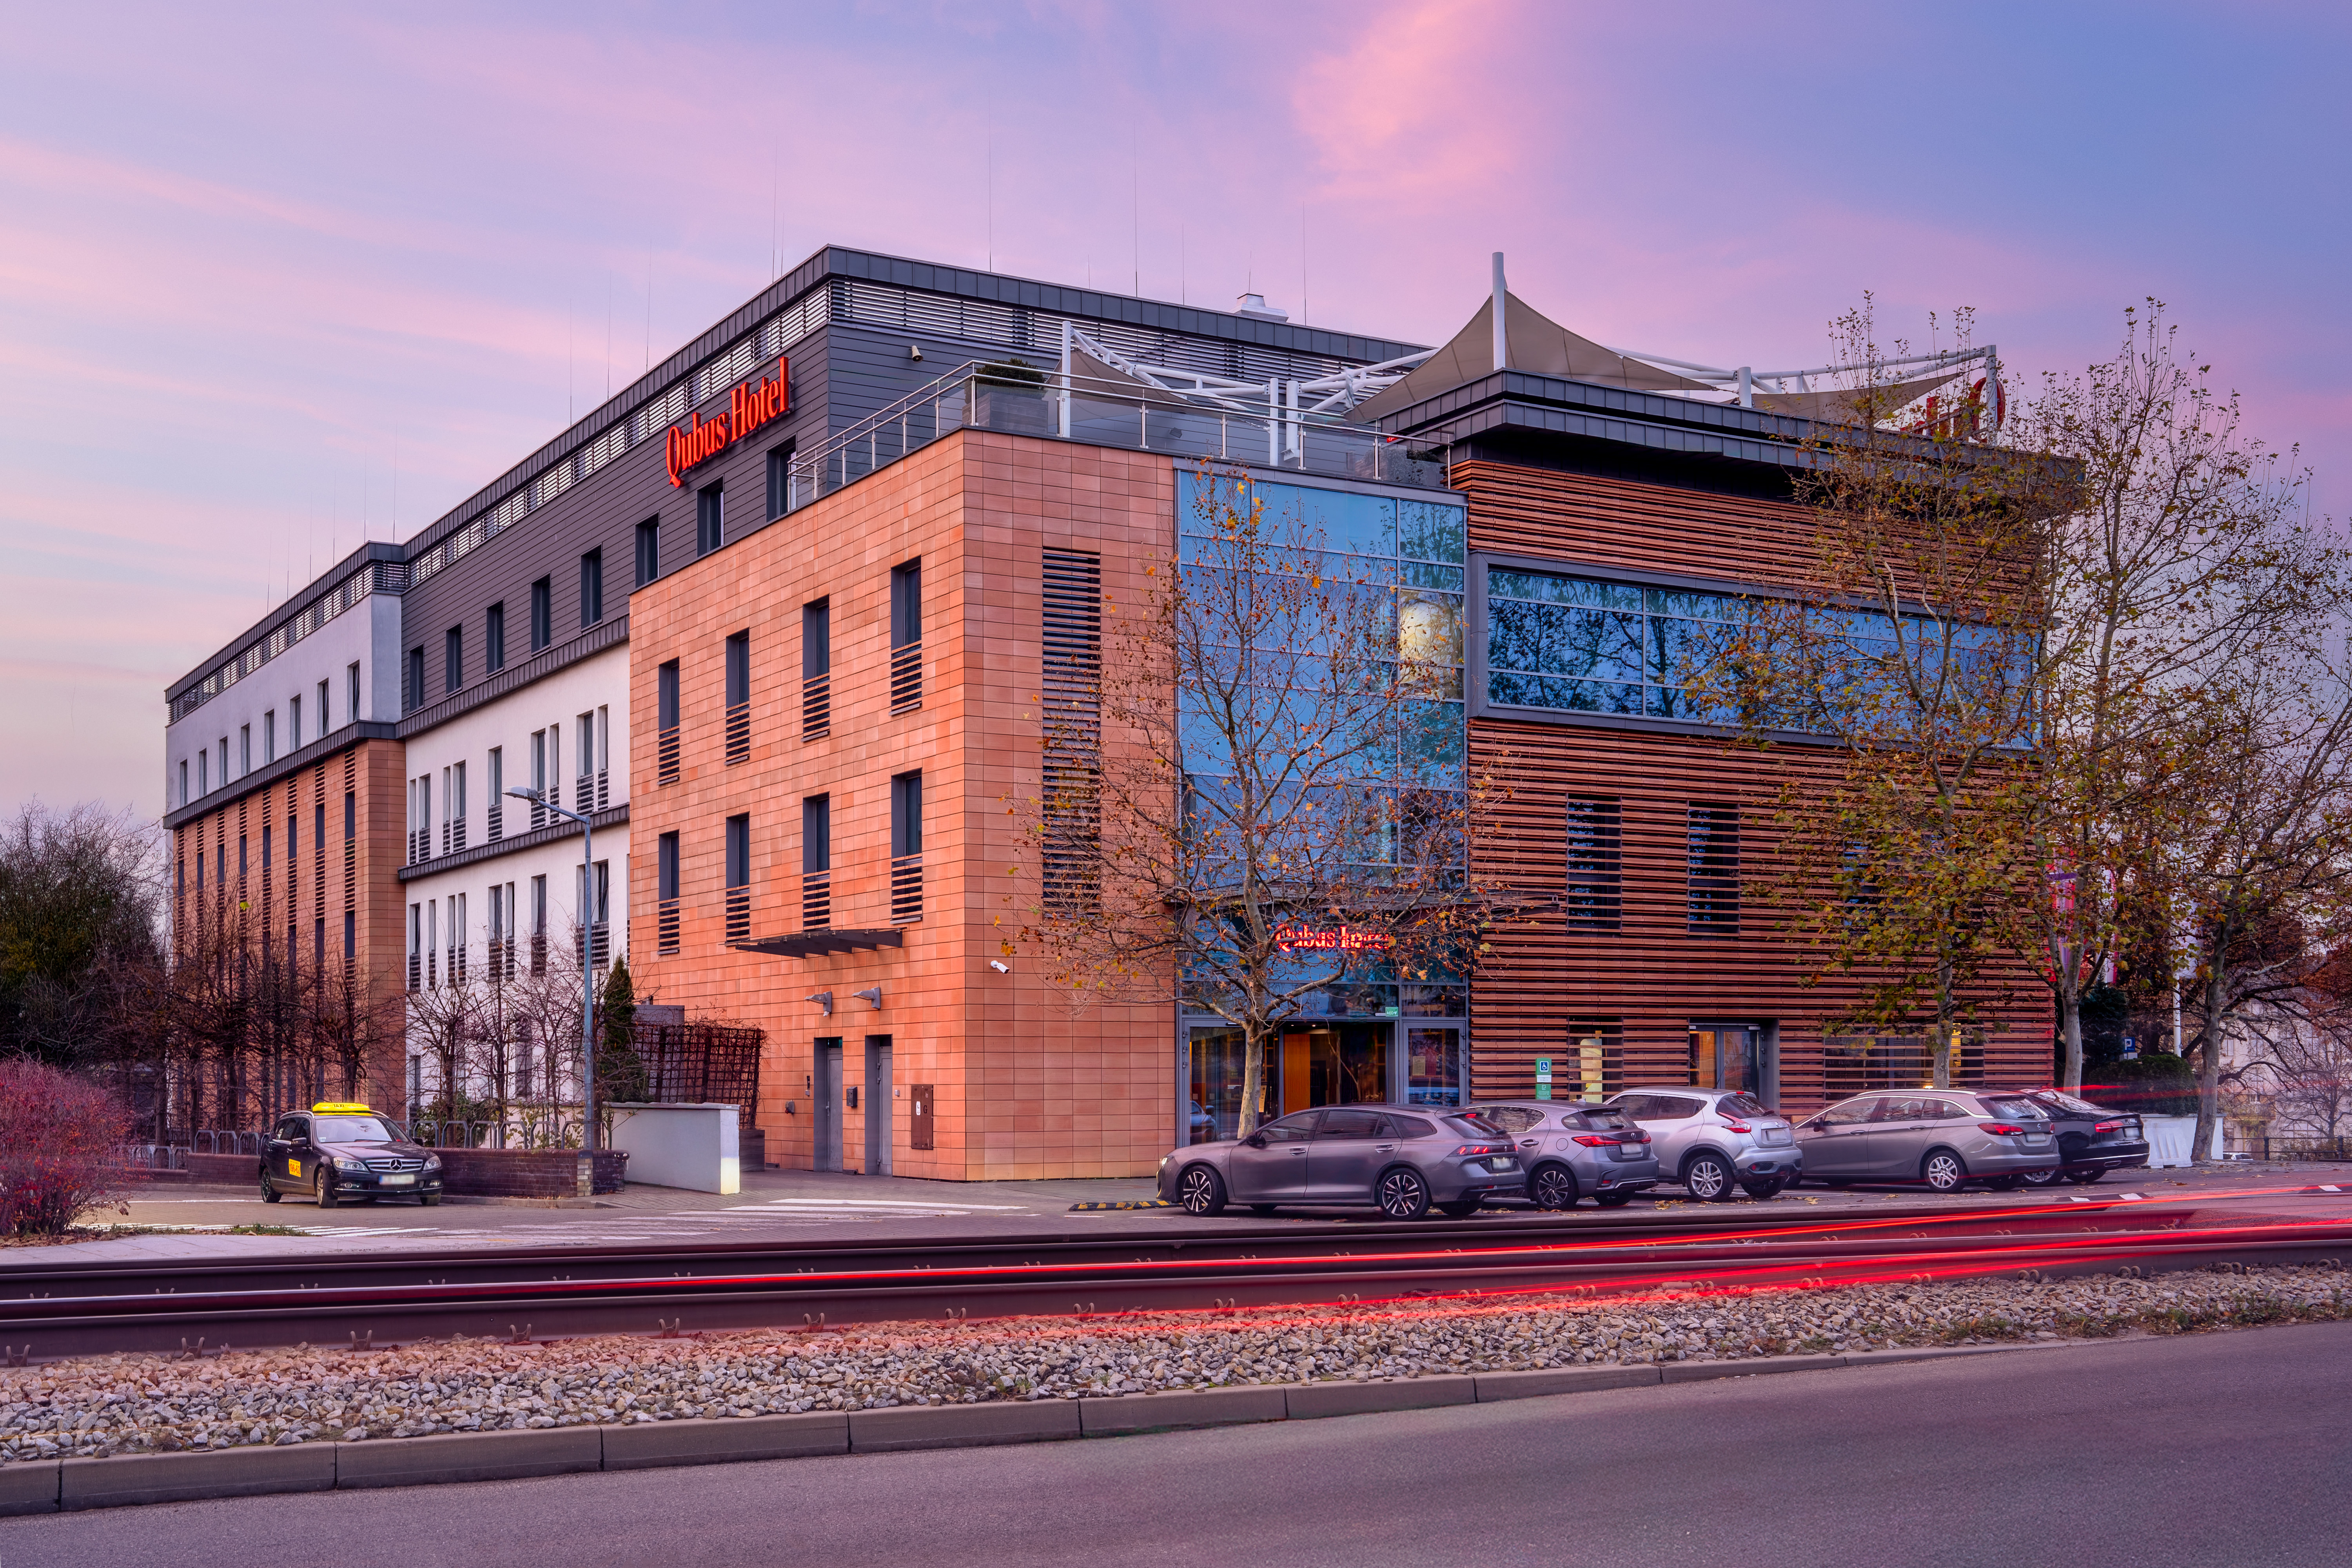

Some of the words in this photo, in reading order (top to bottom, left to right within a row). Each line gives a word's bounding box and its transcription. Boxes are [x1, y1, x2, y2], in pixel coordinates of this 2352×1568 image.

[666, 412, 730, 488] Qubus
[730, 356, 789, 443] Hotel
[2125, 1038, 2132, 1050] P
[923, 1105, 928, 1114] G
[289, 1163, 300, 1174] 196-62
